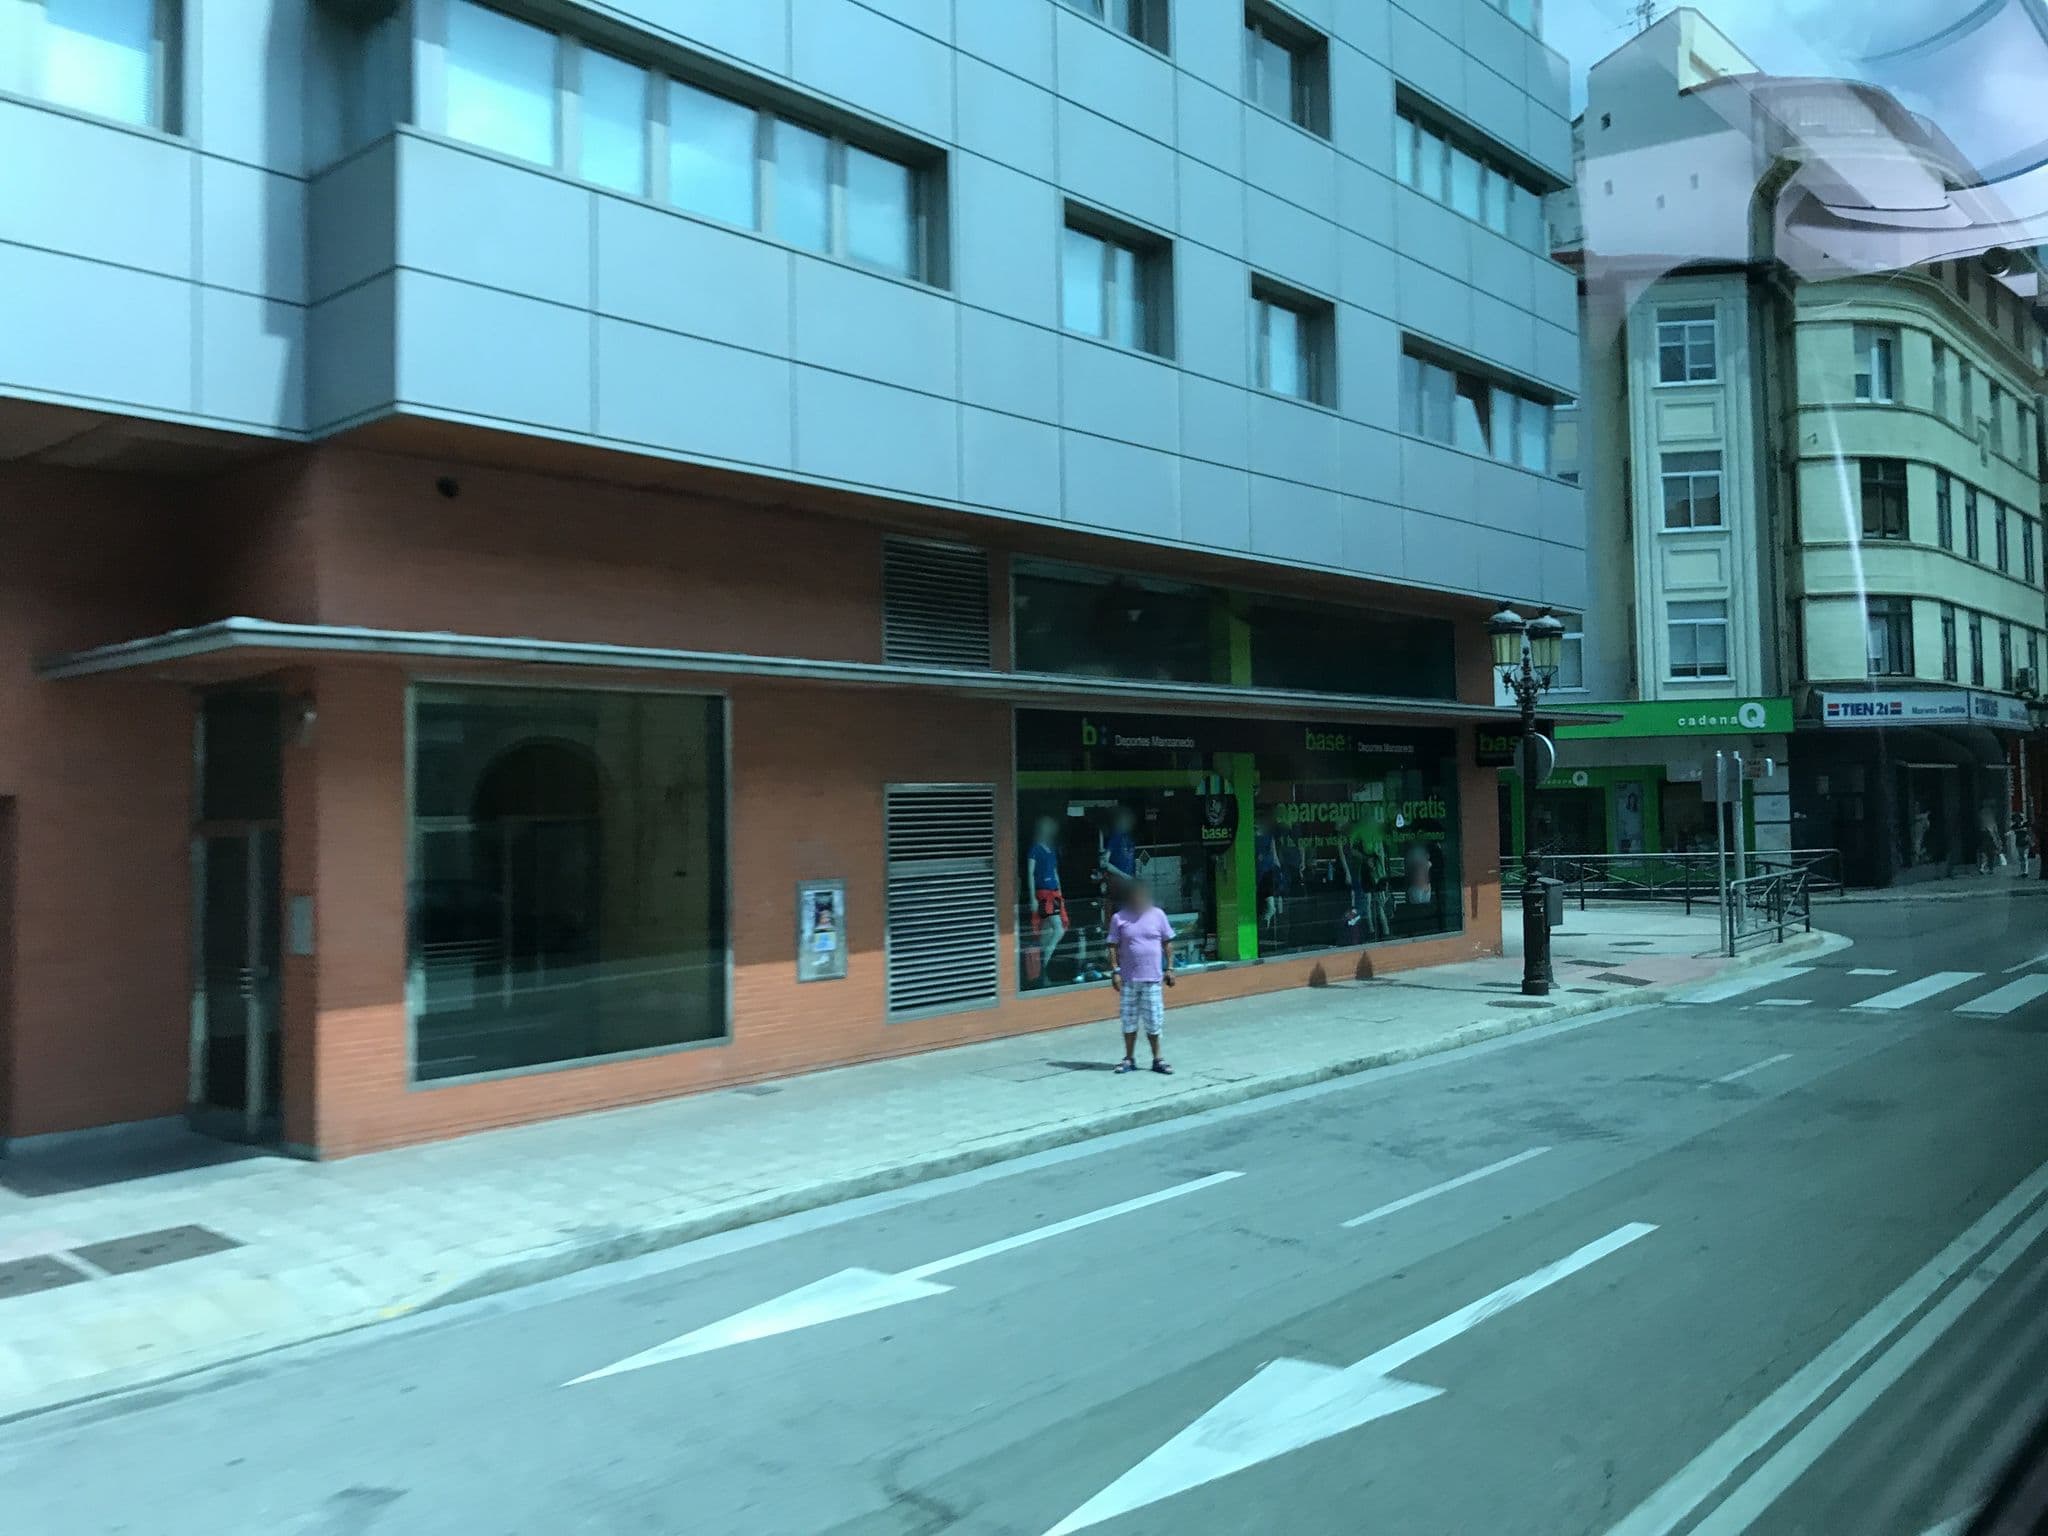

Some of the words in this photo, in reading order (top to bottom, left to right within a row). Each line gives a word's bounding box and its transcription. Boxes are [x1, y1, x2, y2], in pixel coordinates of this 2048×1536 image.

[1841, 703, 1874, 716] TIEN
[1876, 702, 1889, 715] 21
[1402, 795, 1446, 825] gratis
